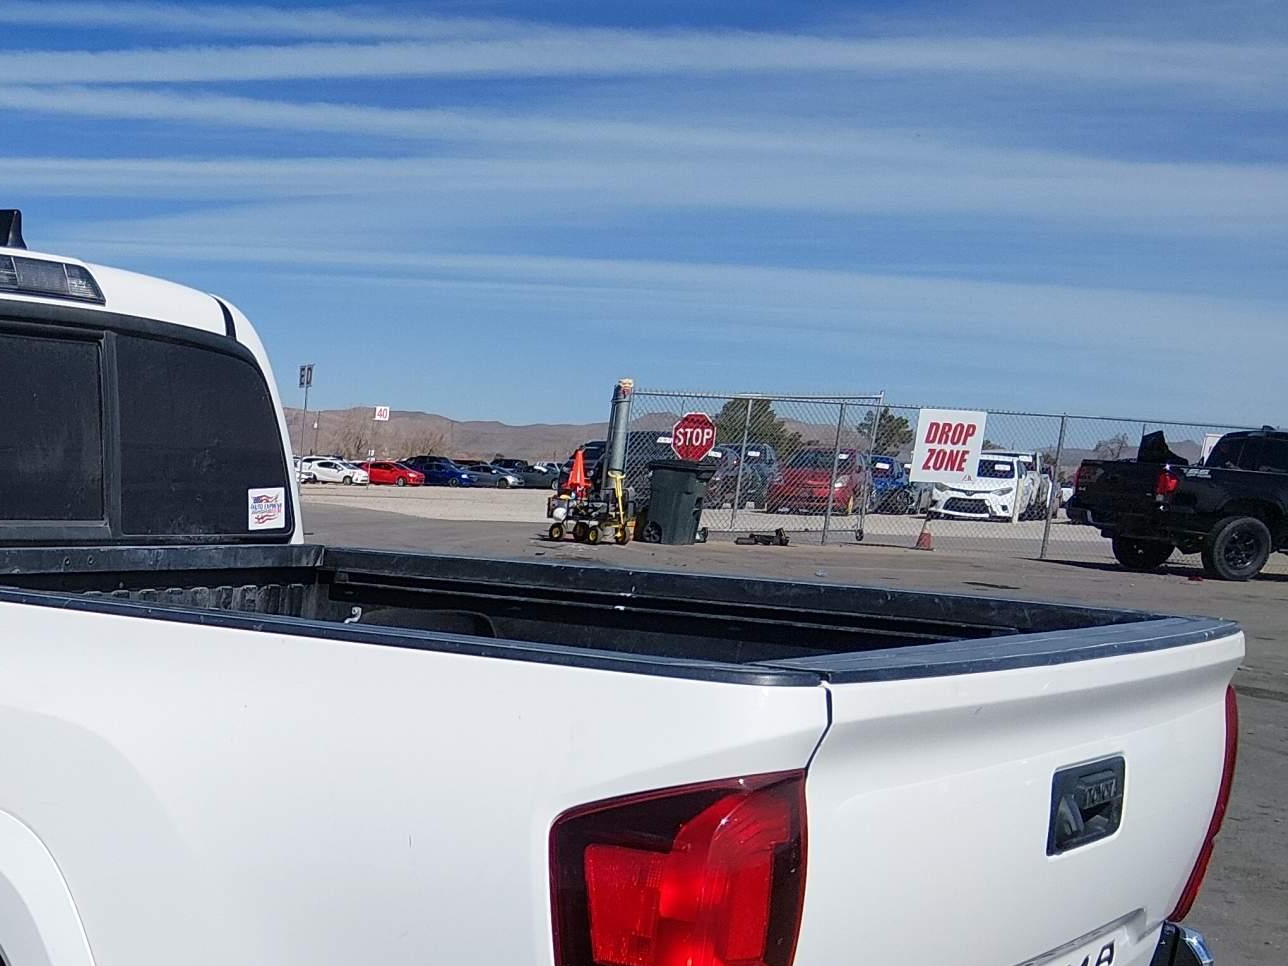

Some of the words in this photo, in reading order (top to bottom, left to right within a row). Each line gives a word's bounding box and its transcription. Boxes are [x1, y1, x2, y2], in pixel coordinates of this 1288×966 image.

[675, 428, 713, 447] STOP
[924, 421, 977, 446] DROP
[921, 447, 971, 473] ZONE
